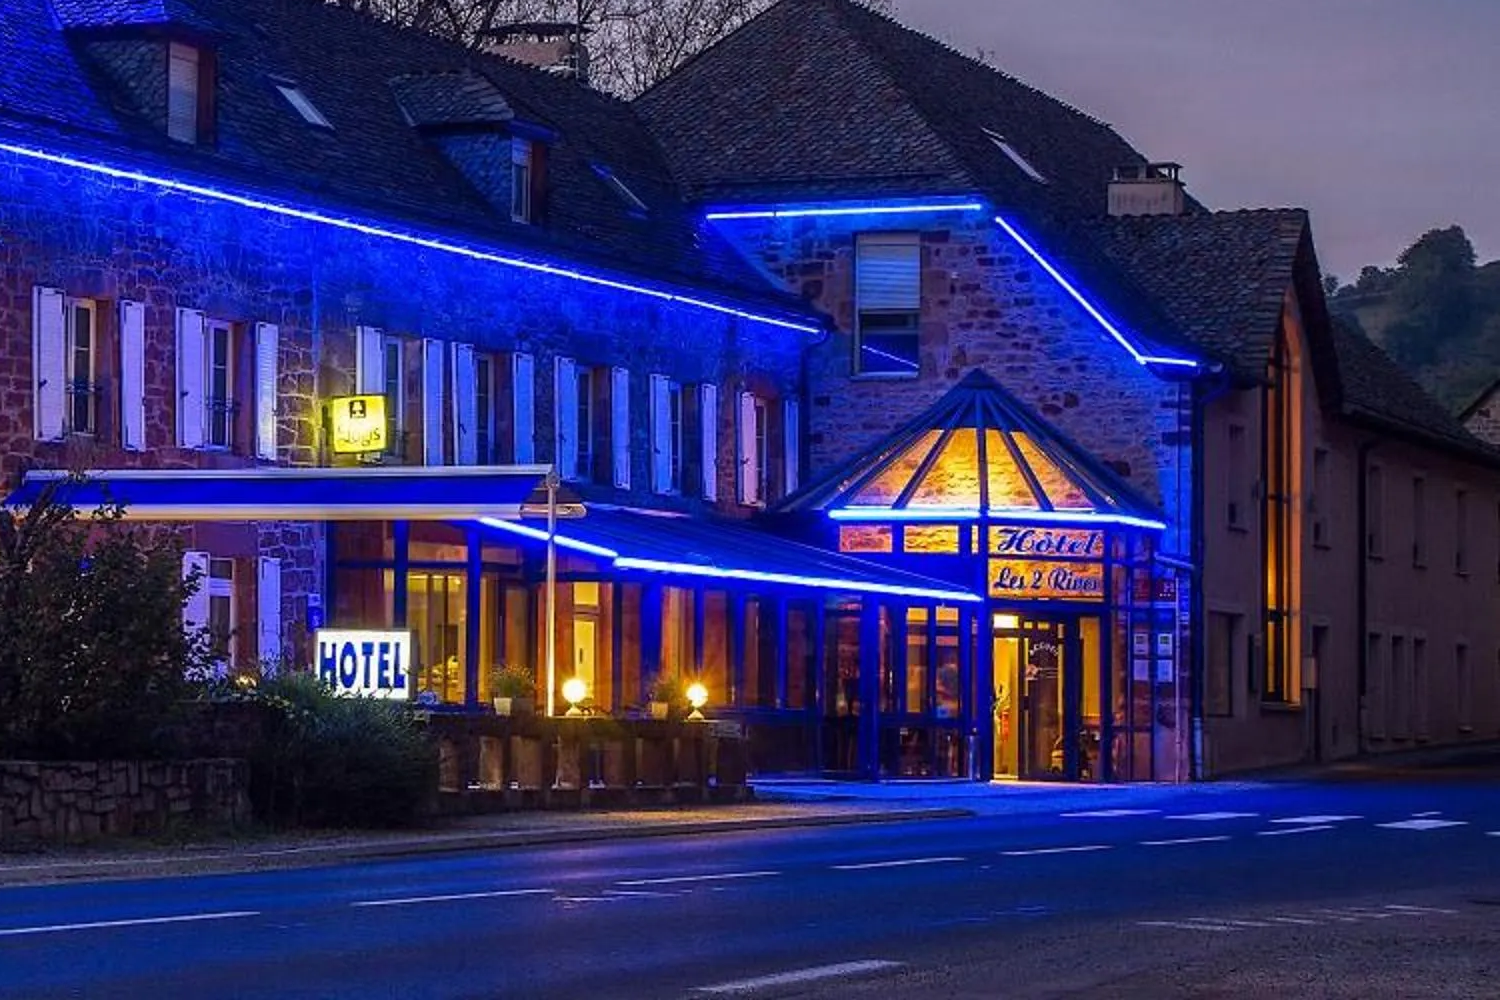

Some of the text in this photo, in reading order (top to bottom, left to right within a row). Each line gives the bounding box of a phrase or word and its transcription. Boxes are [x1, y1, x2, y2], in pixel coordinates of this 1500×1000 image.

[997, 528, 1097, 554] Hôtel
[994, 567, 1025, 589] Les
[1031, 569, 1043, 589] 2
[320, 641, 406, 690] HOTEL
